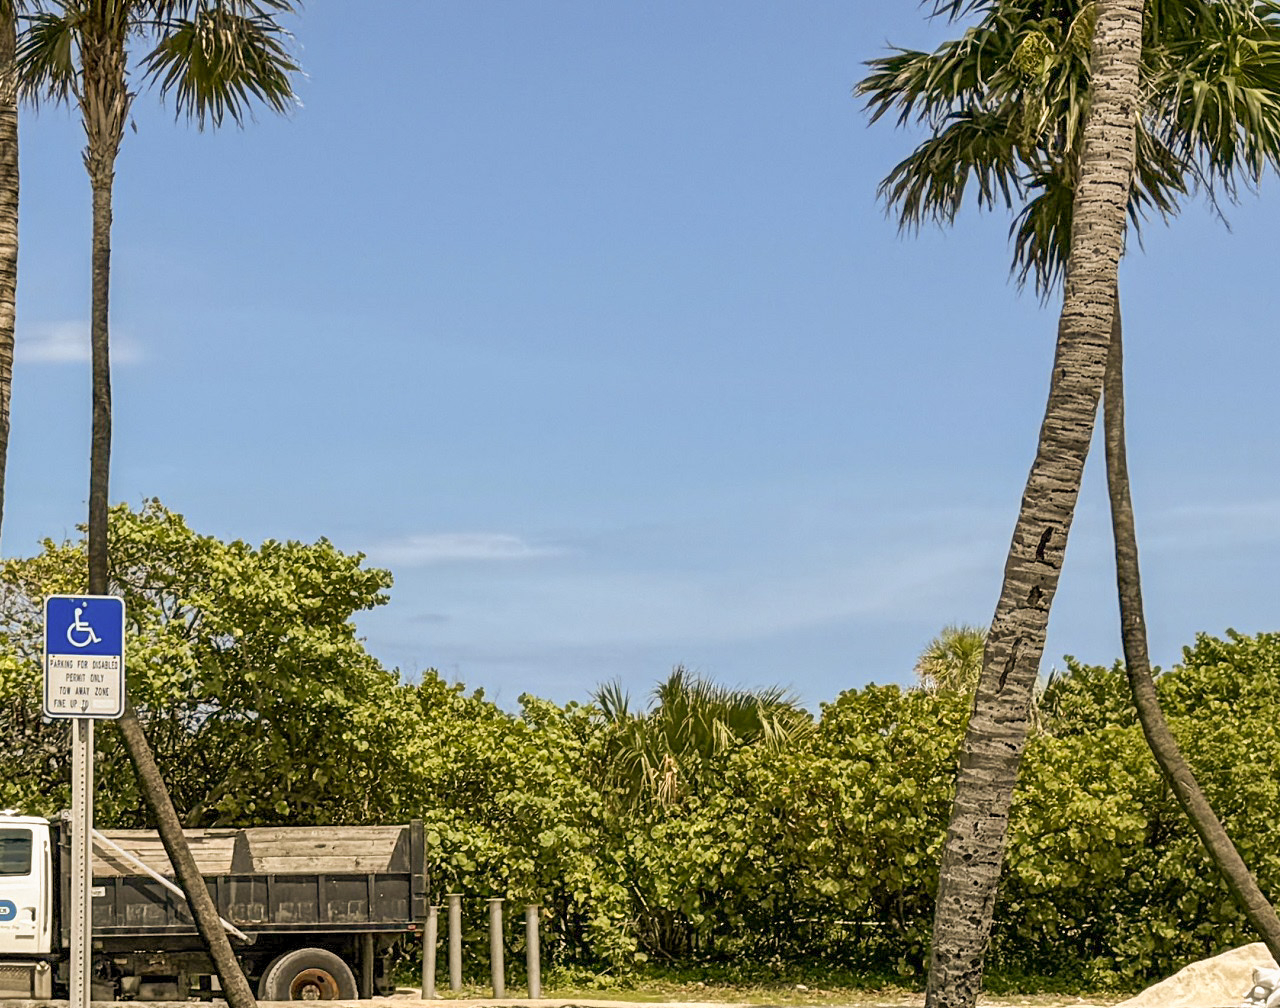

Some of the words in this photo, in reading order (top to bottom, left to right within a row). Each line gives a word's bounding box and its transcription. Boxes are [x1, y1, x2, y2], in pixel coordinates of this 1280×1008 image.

[50, 660, 73, 669] PARKING
[77, 660, 88, 669] FOR
[92, 660, 118, 669] DISABLED
[65, 673, 85, 682] PERMIT
[90, 674, 104, 682] ONLY
[59, 686, 71, 695] TOW
[75, 687, 90, 695] AWAY
[95, 687, 109, 696] ZONE
[54, 699, 66, 708] FINE
[70, 699, 77, 708] UP
